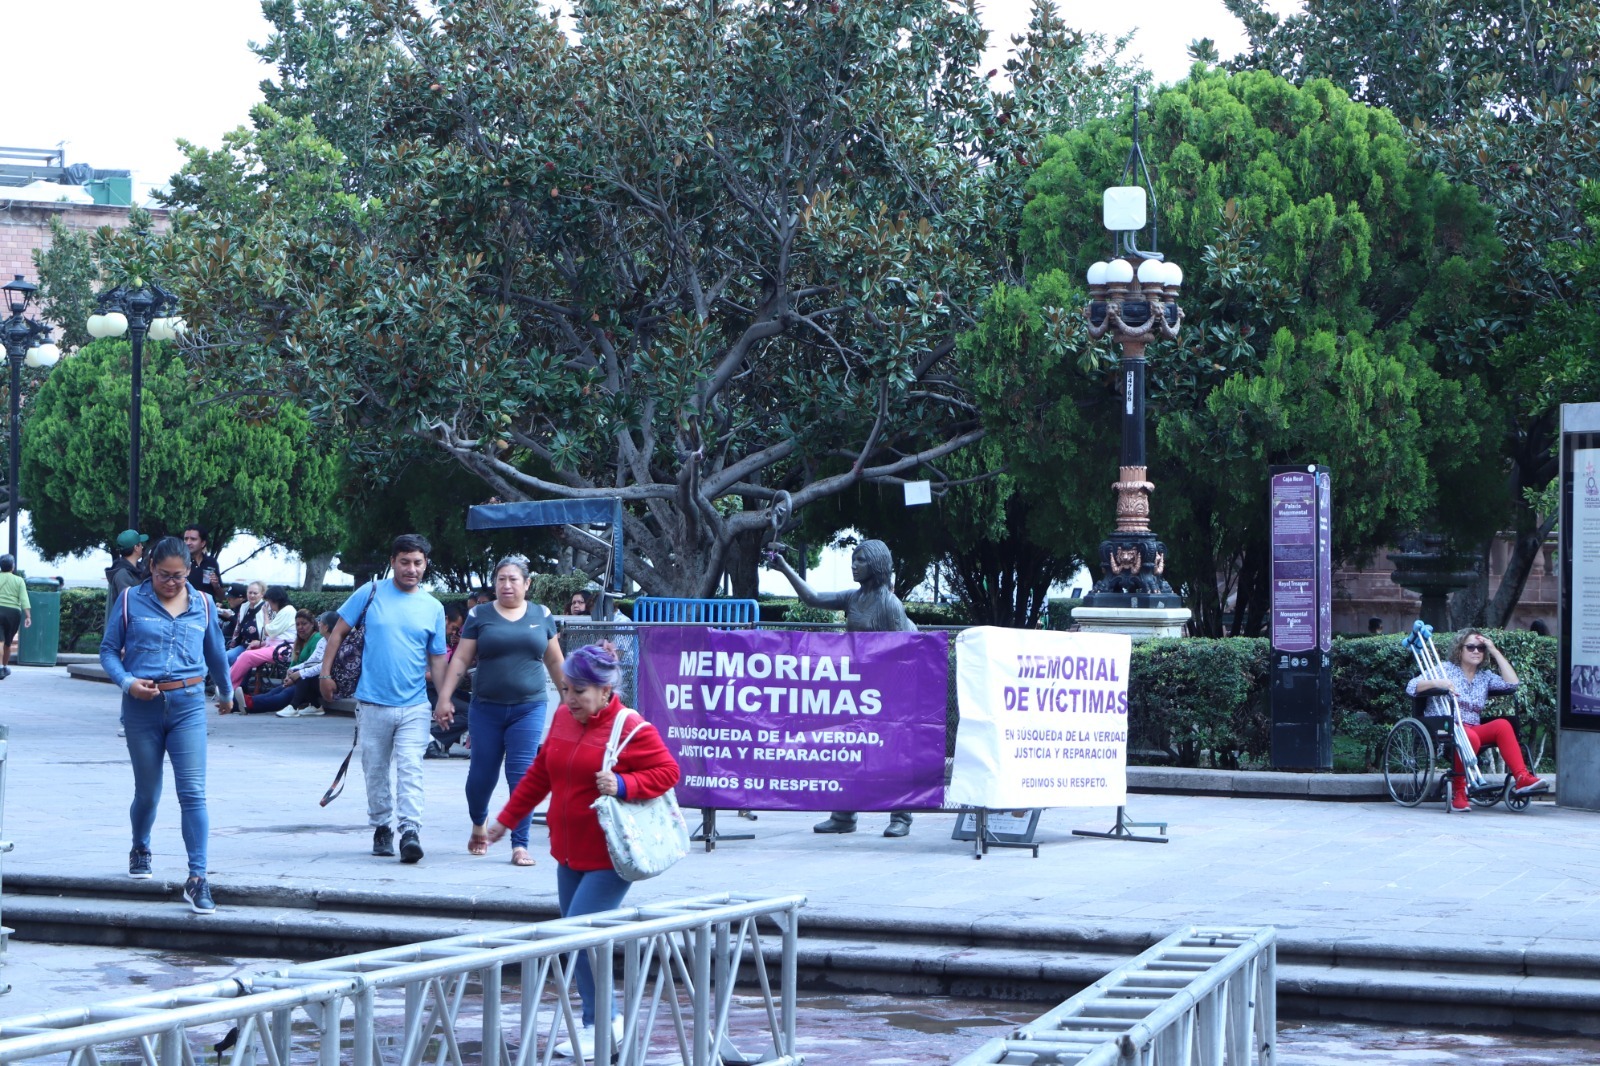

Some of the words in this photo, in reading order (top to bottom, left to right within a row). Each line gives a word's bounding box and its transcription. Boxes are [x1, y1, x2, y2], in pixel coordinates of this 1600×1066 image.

[679, 651, 861, 682] MEMORIAL
[1017, 655, 1119, 682] MEMORIAL
[665, 684, 694, 710] DE
[700, 679, 882, 715] VÍCTIMAS
[1004, 686, 1030, 711] DE
[1036, 681, 1128, 714] VÍCTIMAS
[667, 726, 680, 739] EN
[680, 725, 753, 742] BÚSQUEDA
[757, 729, 780, 742] DE
[785, 731, 807, 743] LA
[812, 731, 884, 747] VERDAD,
[1005, 729, 1015, 740] EN
[1066, 730, 1077, 742] DE
[1079, 730, 1090, 742] LA
[1093, 731, 1127, 742] VERDAD
[678, 744, 732, 759] JUSTICIA
[737, 747, 749, 760] Y
[753, 744, 862, 762] REPARACIÓN
[1054, 747, 1060, 759] Y
[685, 775, 739, 788] PEDIMOS
[743, 778, 765, 790] SU
[769, 778, 843, 791] RESPETO.
[1021, 777, 1055, 788] PEDIMOS
[1057, 778, 1068, 788] SU
[1070, 778, 1108, 788] RESPETO.
